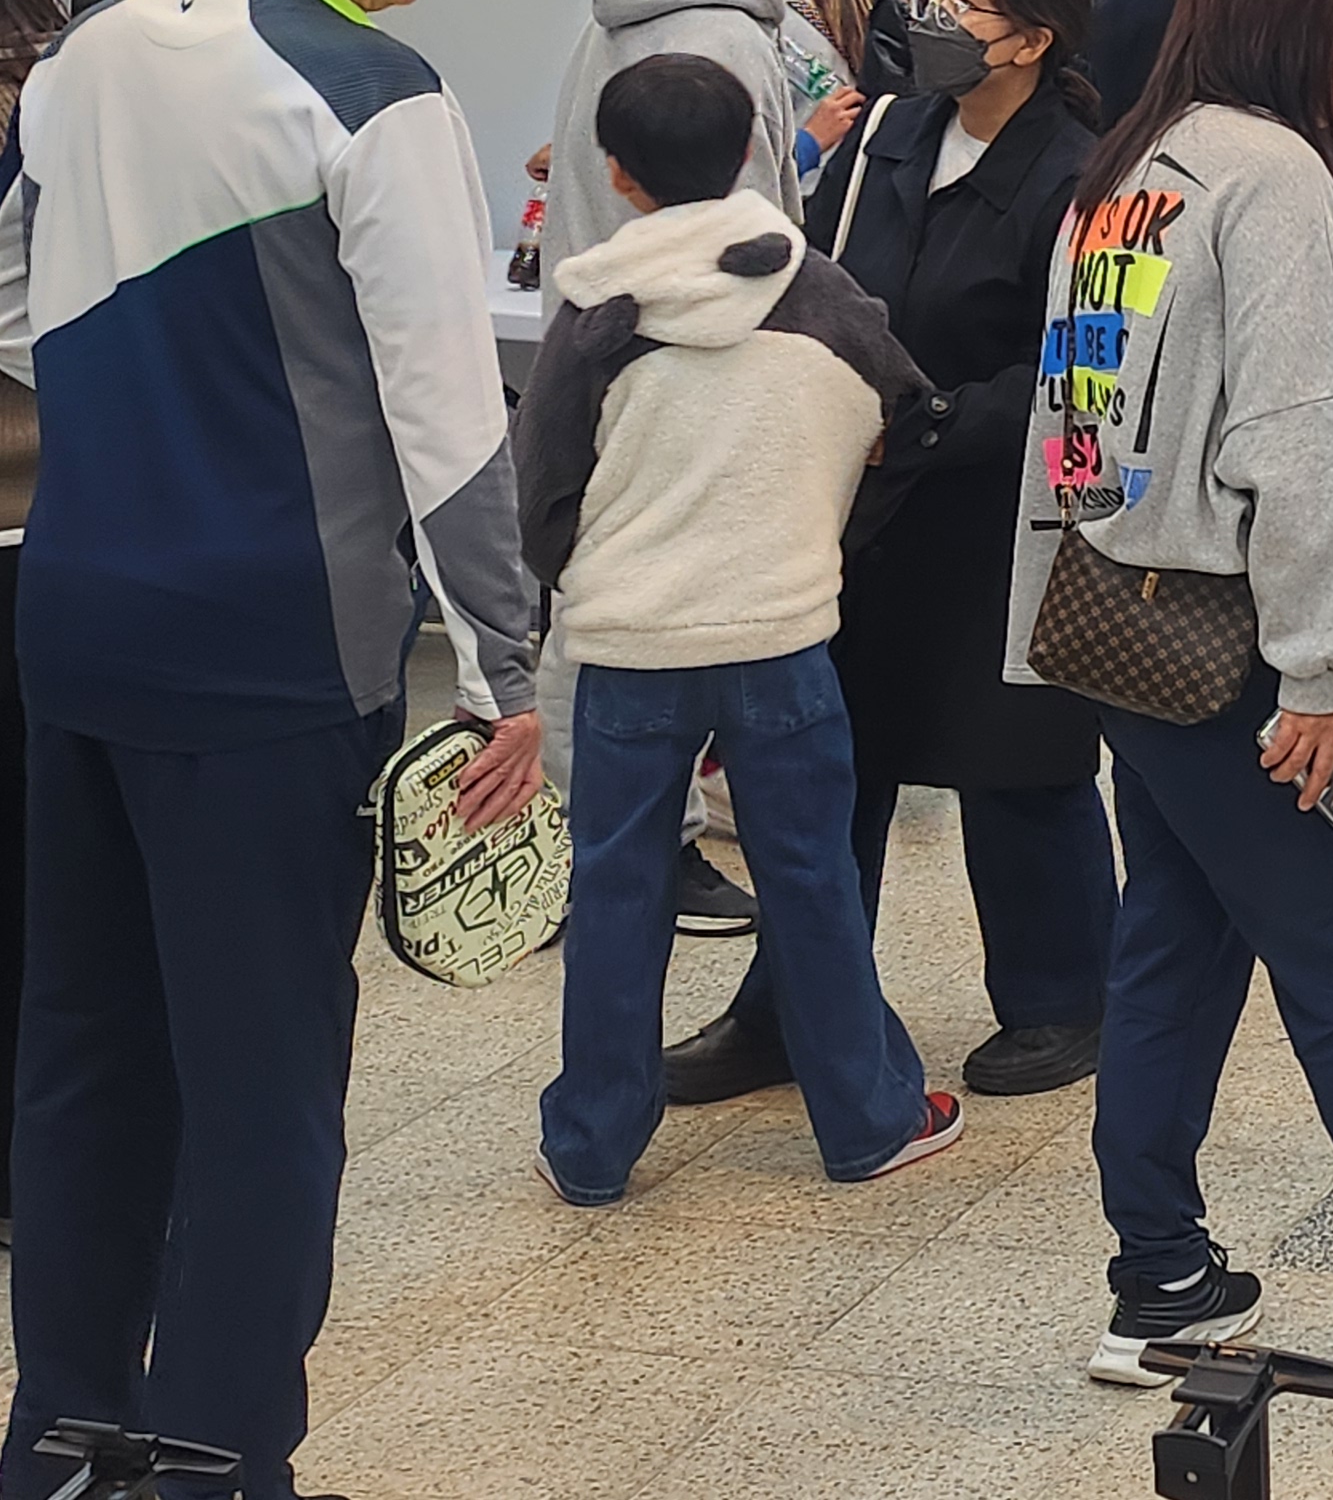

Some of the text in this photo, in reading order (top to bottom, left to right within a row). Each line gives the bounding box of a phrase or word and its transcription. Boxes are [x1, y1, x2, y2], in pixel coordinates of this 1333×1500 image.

[1121, 188, 1186, 256] OK
[1079, 250, 1136, 313] NOT
[1085, 323, 1107, 366] BE
